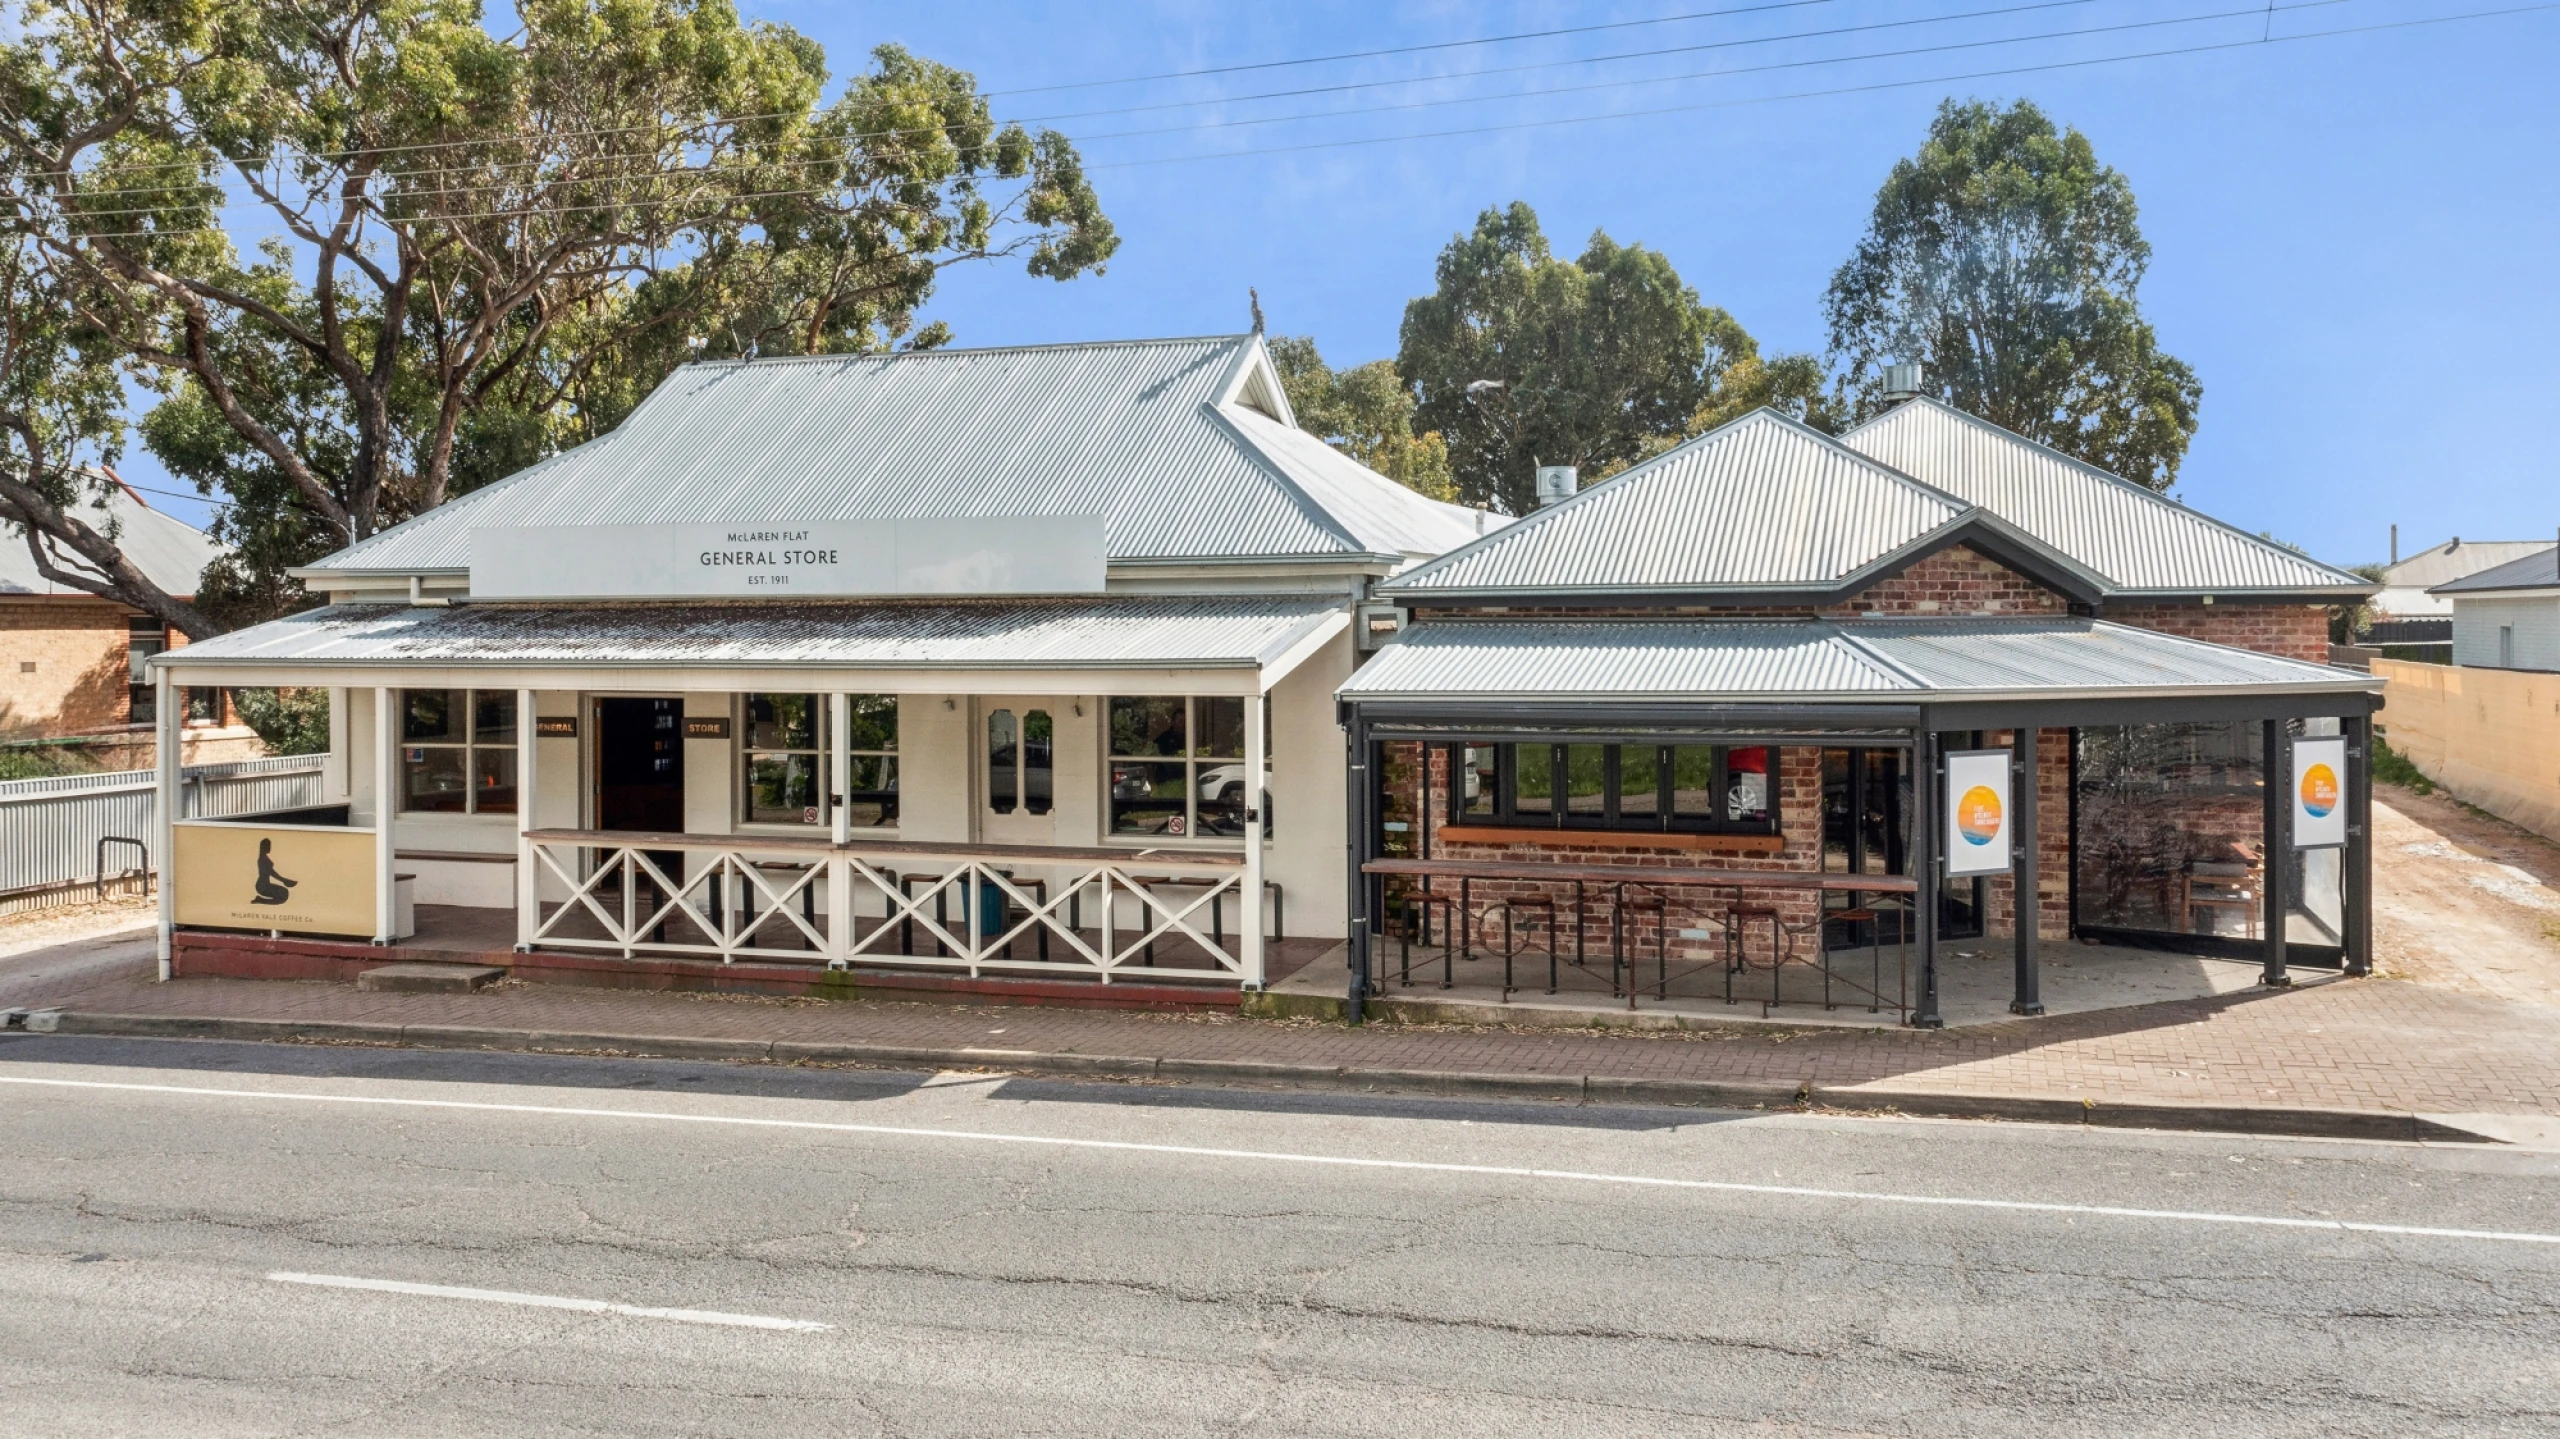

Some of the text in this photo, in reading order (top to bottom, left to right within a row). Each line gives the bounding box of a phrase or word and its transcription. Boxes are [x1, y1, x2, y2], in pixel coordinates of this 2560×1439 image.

[727, 531, 809, 542] McLAREN FLAT
[700, 550, 838, 566] GENERAL STORE
[748, 575, 789, 585] EST. 1911
[688, 724, 720, 733] STORE
